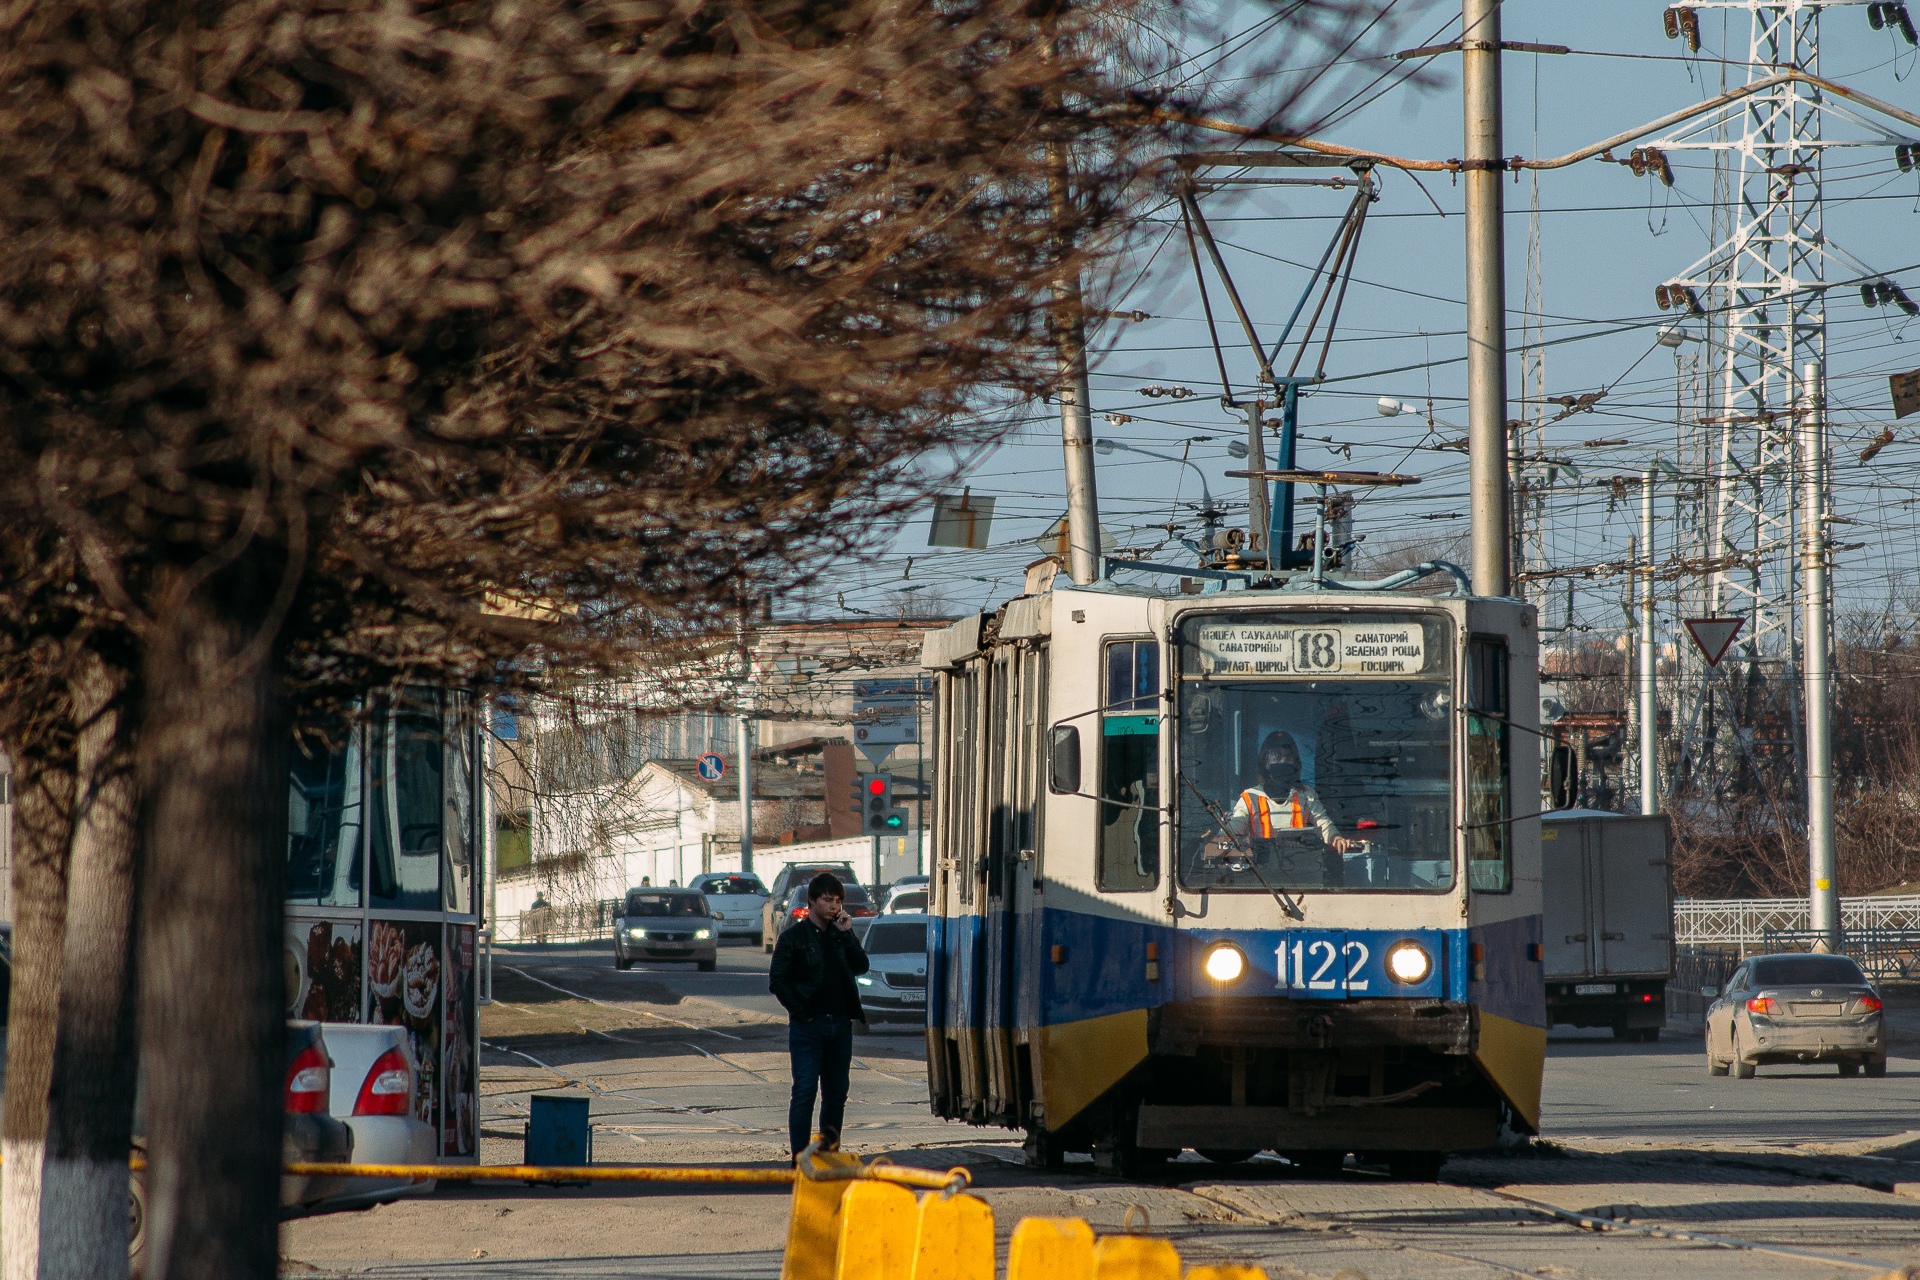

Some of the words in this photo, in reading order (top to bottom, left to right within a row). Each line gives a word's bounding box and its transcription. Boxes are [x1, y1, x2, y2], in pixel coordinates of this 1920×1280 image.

[1355, 631, 1408, 643] САНАТОРИЙ
[1219, 641, 1282, 652] САНАТОРИЙЫ
[1298, 633, 1335, 668] 18
[1345, 646, 1387, 656] ЗЕЛЕНАЯ
[1393, 646, 1420, 657] РОЩА
[1256, 661, 1289, 673] ЦИРКЫ
[1361, 661, 1404, 672] ГОСЦИРК
[1274, 940, 1369, 990] 1122
